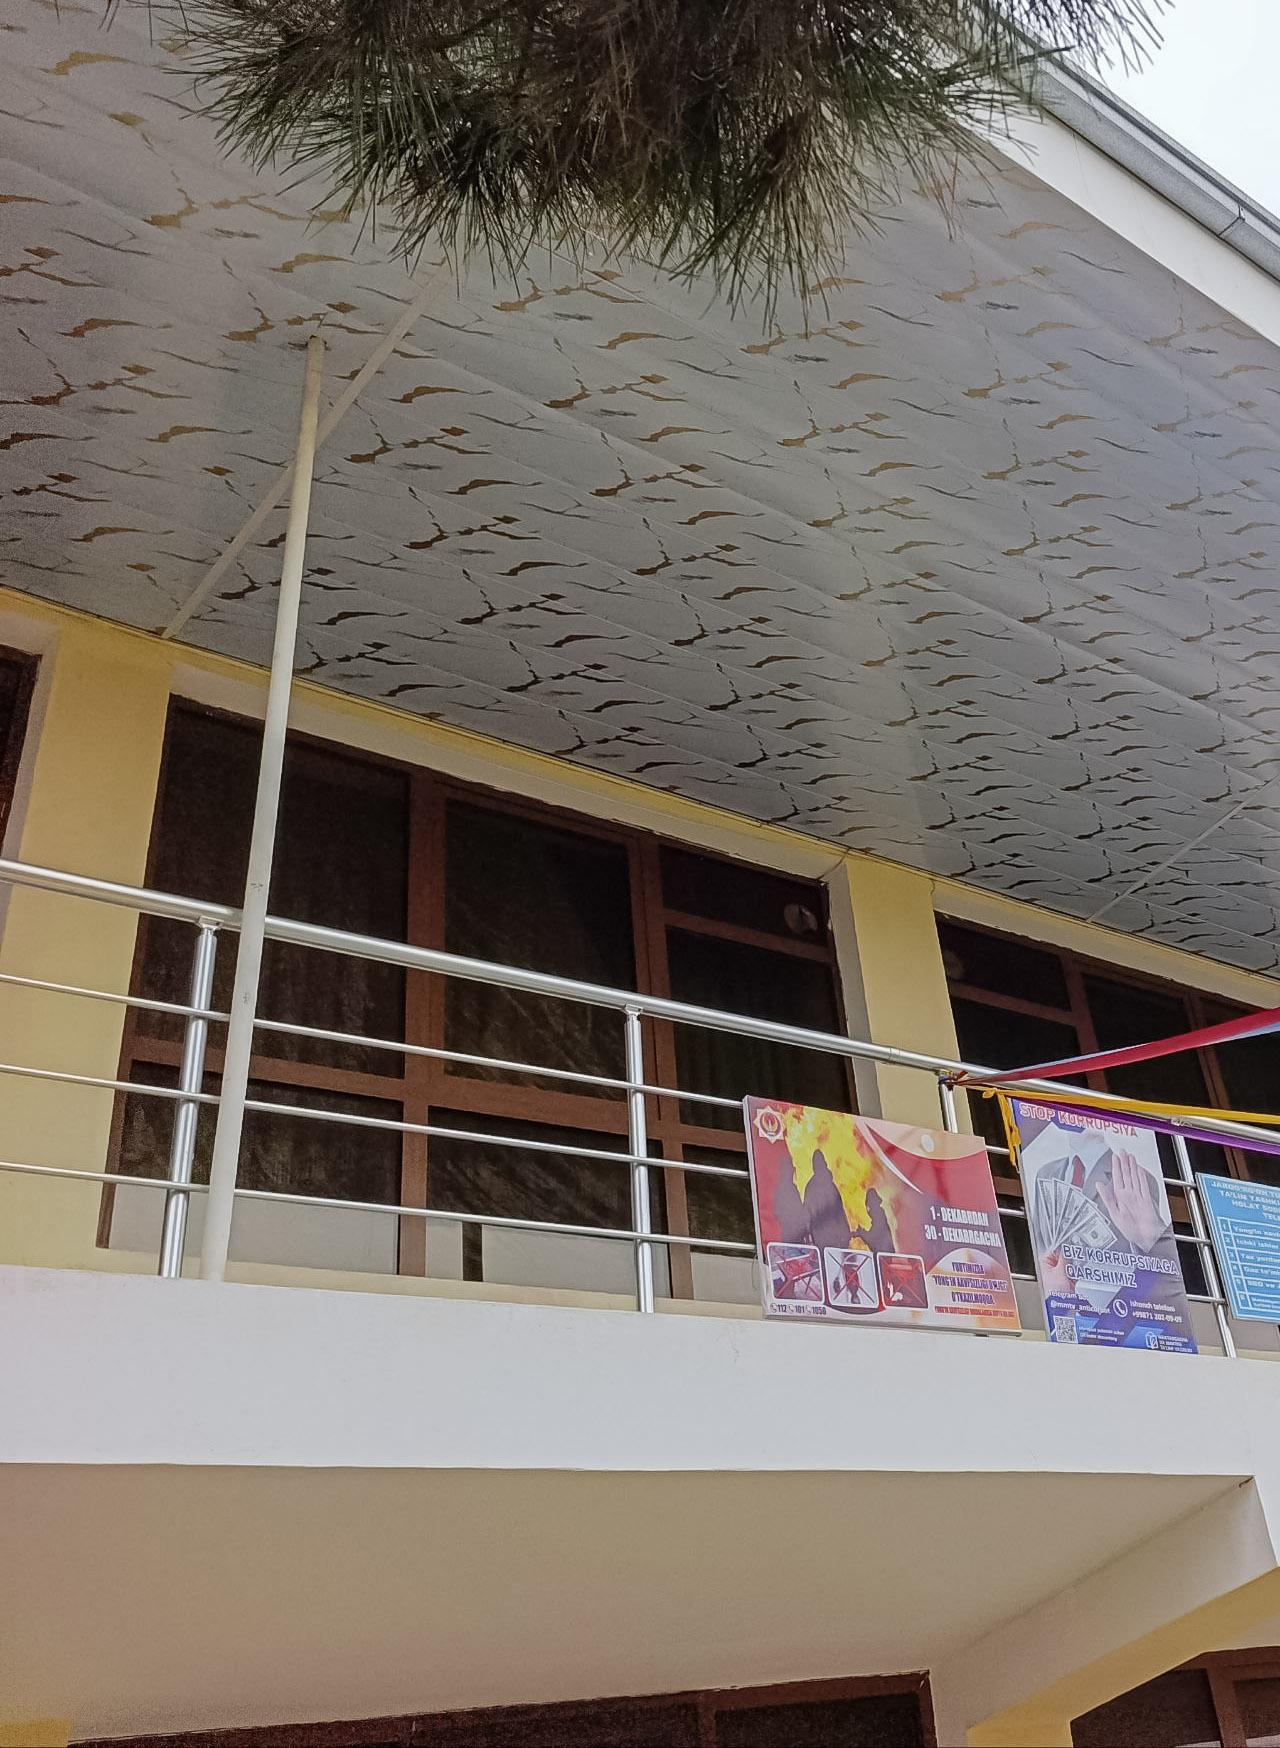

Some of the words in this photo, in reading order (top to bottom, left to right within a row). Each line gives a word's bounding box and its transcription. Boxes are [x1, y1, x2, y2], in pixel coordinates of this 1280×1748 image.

[1019, 1102, 1055, 1120] STOP
[1058, 1111, 1138, 1137] KORRUPSIYA
[925, 1225, 938, 1240] 30
[1063, 1244, 1085, 1260] BIZ
[1087, 1247, 1180, 1275] KORRUPSIYAGA
[1066, 1264, 1137, 1288] QARSHIMIZ
